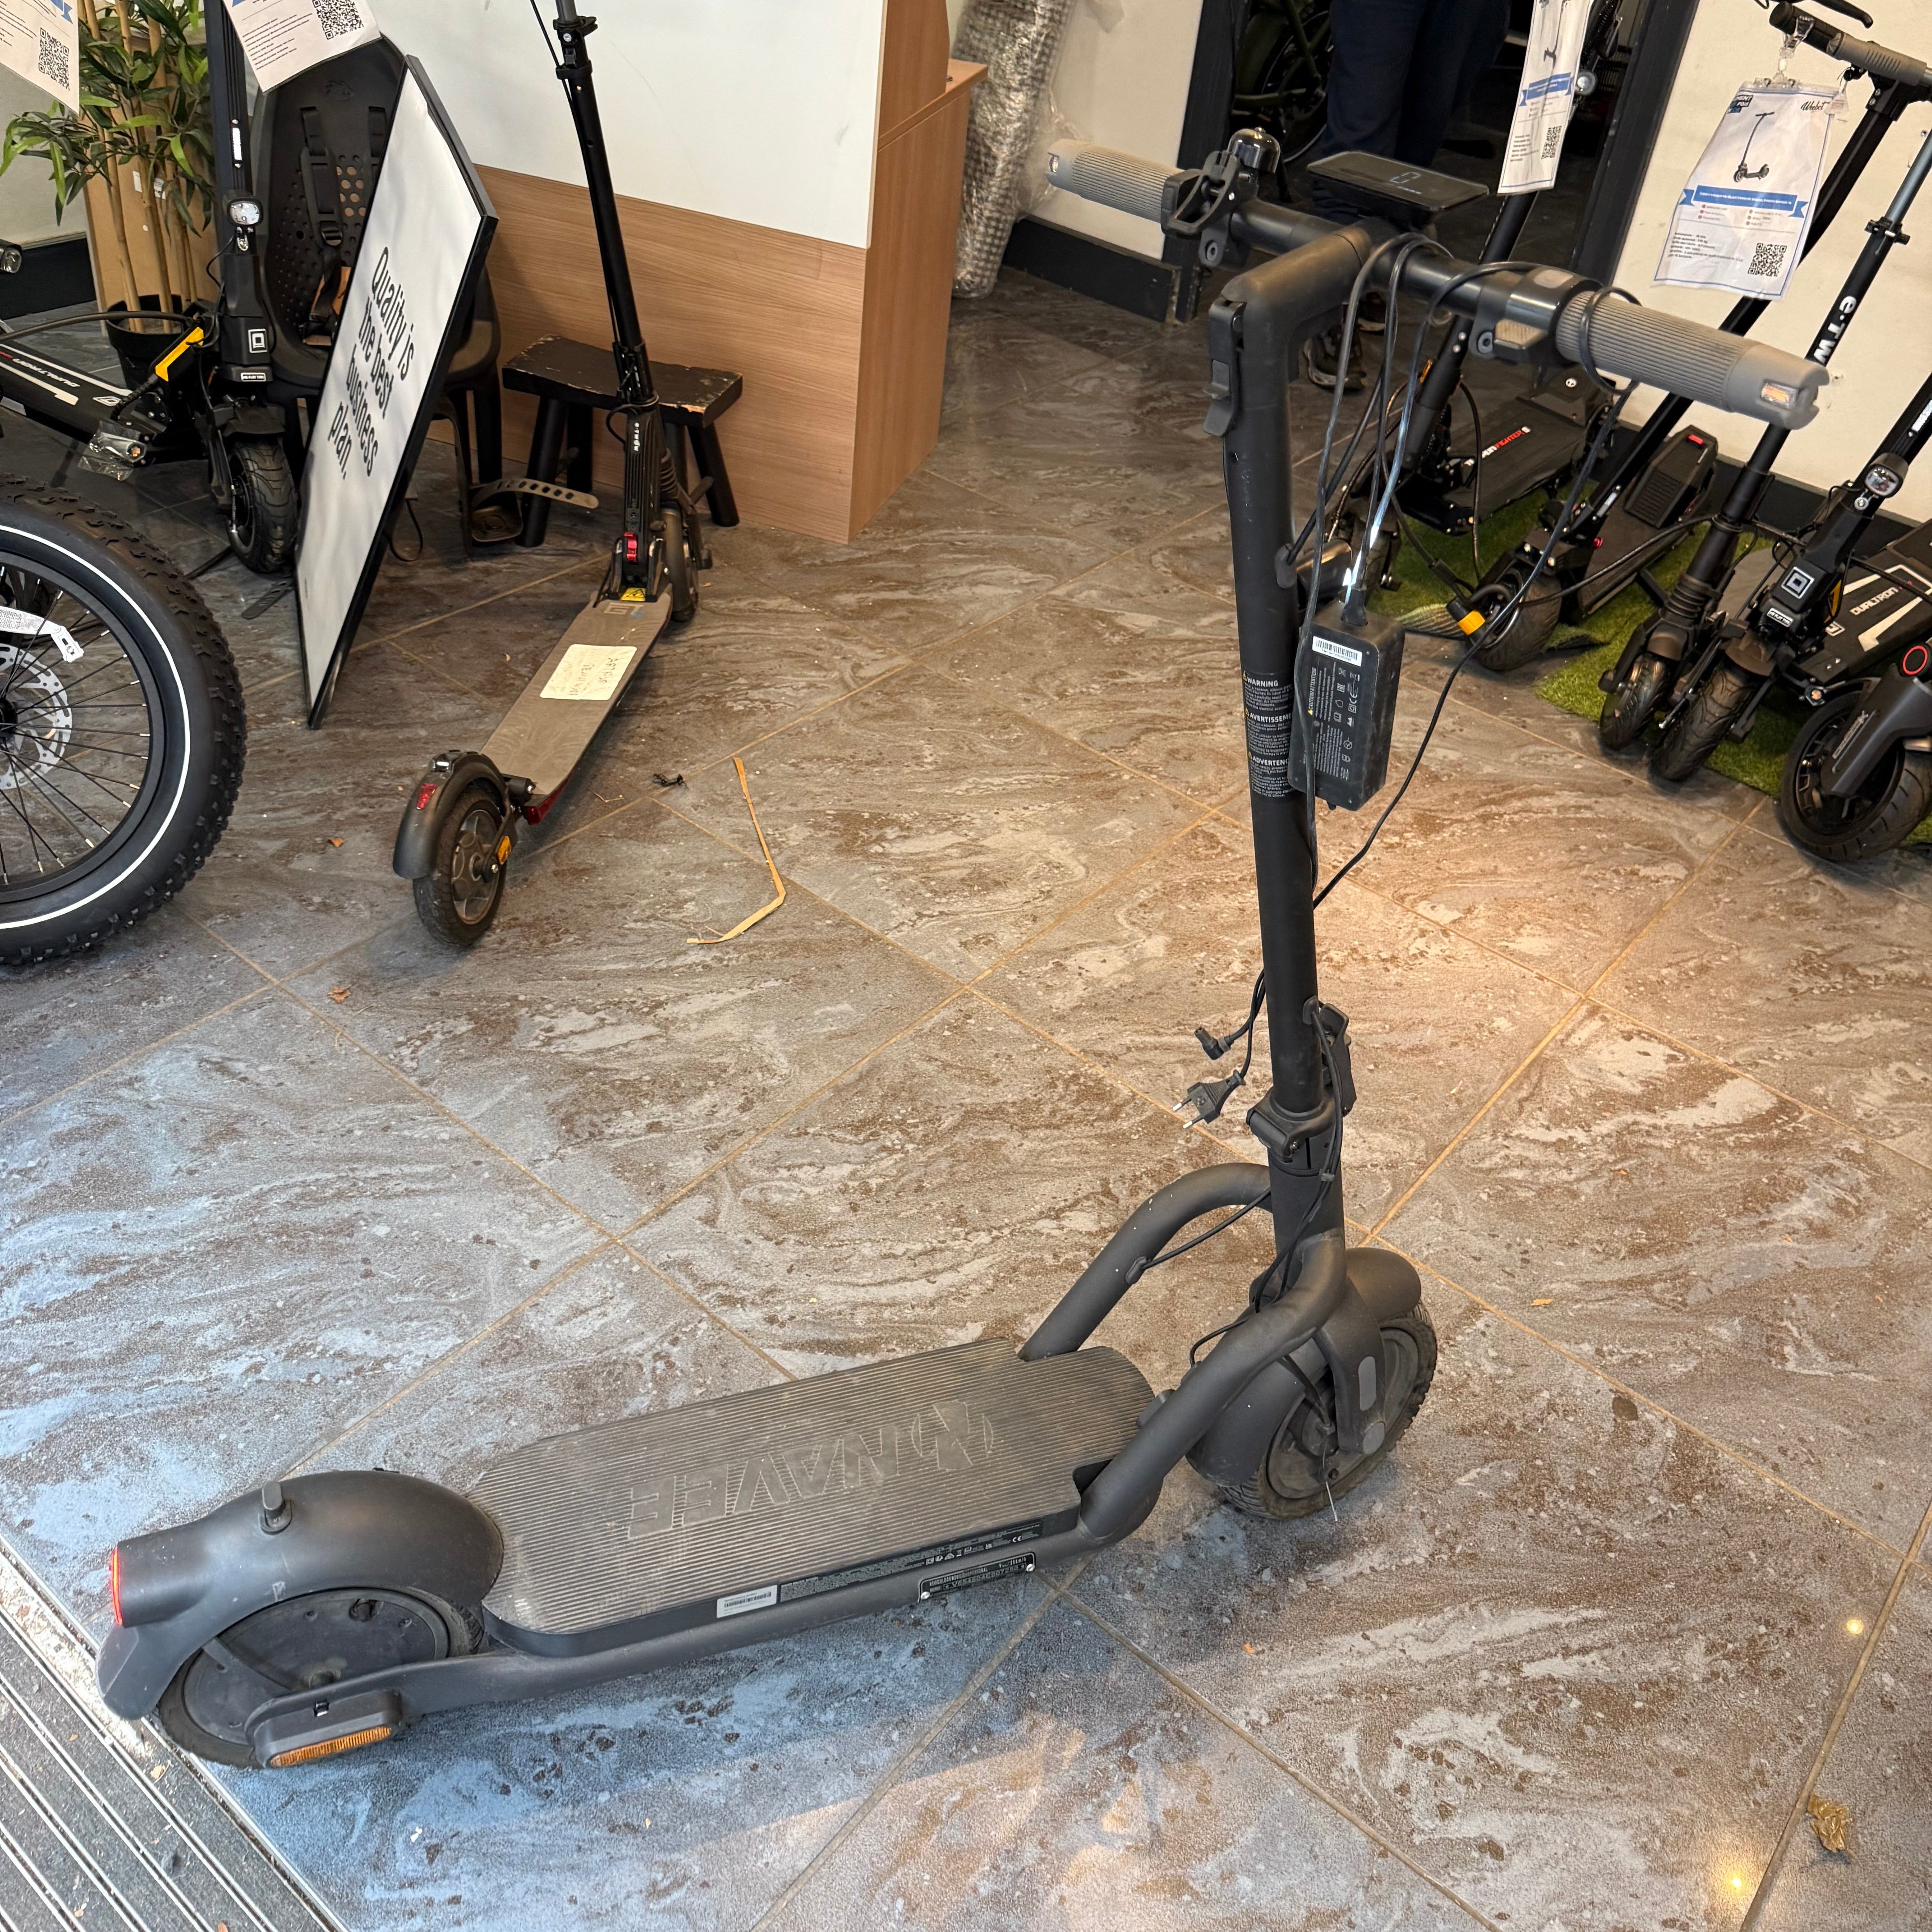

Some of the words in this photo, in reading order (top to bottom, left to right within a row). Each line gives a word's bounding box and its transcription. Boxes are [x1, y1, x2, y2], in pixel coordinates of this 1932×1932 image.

[359, 296, 375, 362] the
[371, 333, 394, 420] best
[372, 247, 407, 361] Quality
[398, 323, 414, 381] is
[328, 401, 352, 480] plan.
[346, 344, 378, 477] business
[1850, 587, 1899, 616] DUALTRON
[1247, 676, 1279, 687] WARNING
[628, 1425, 900, 1539] NAVEE
